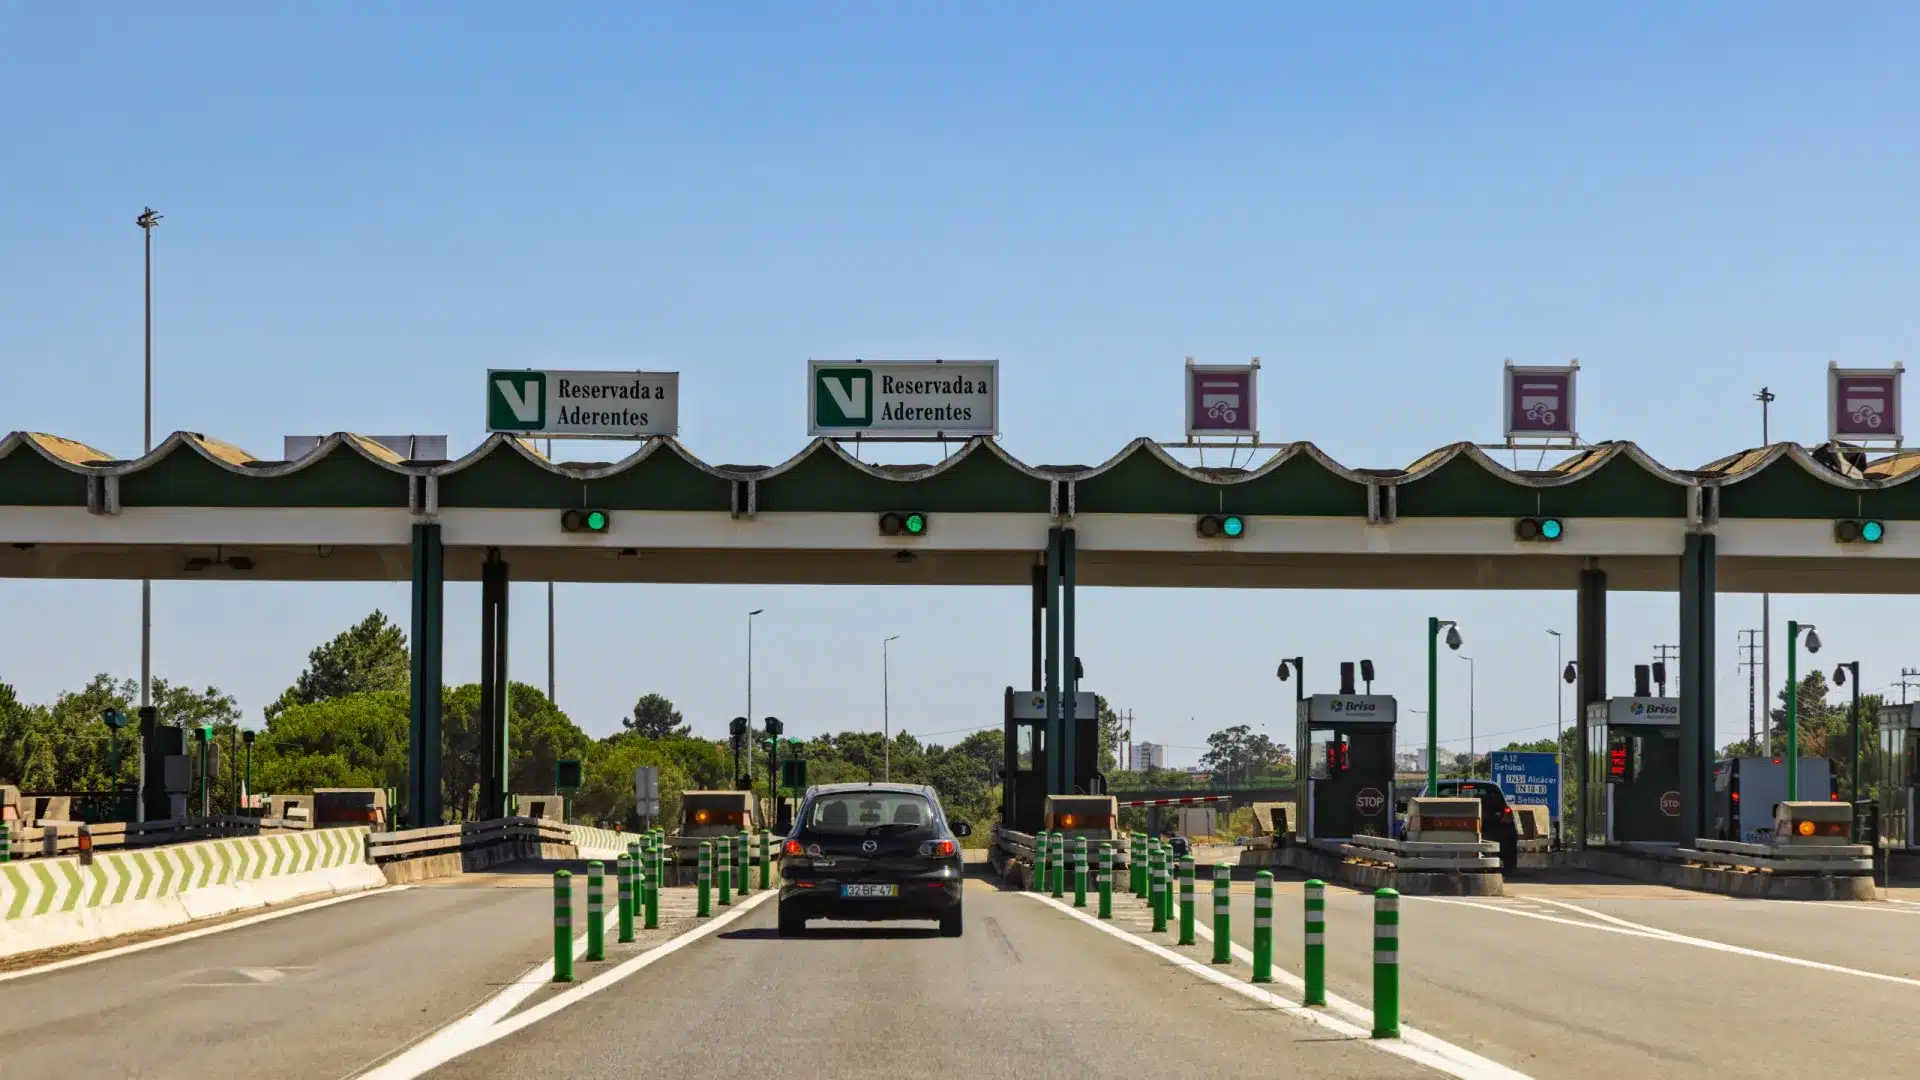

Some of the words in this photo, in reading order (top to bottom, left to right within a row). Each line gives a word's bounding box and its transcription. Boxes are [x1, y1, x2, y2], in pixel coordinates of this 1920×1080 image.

[558, 379, 650, 400] Reservada
[655, 386, 664, 400] a
[882, 375, 974, 395] Reservada
[978, 382, 988, 394] a
[557, 406, 649, 426] Aderentes
[881, 402, 972, 421] Aderentes
[1346, 701, 1376, 711] Brisa
[1646, 704, 1677, 714] Brisa
[1494, 763, 1525, 771] Setúbal
[1357, 797, 1383, 807] STOP
[1517, 796, 1548, 804] Setúbal
[1662, 799, 1680, 807] STO
